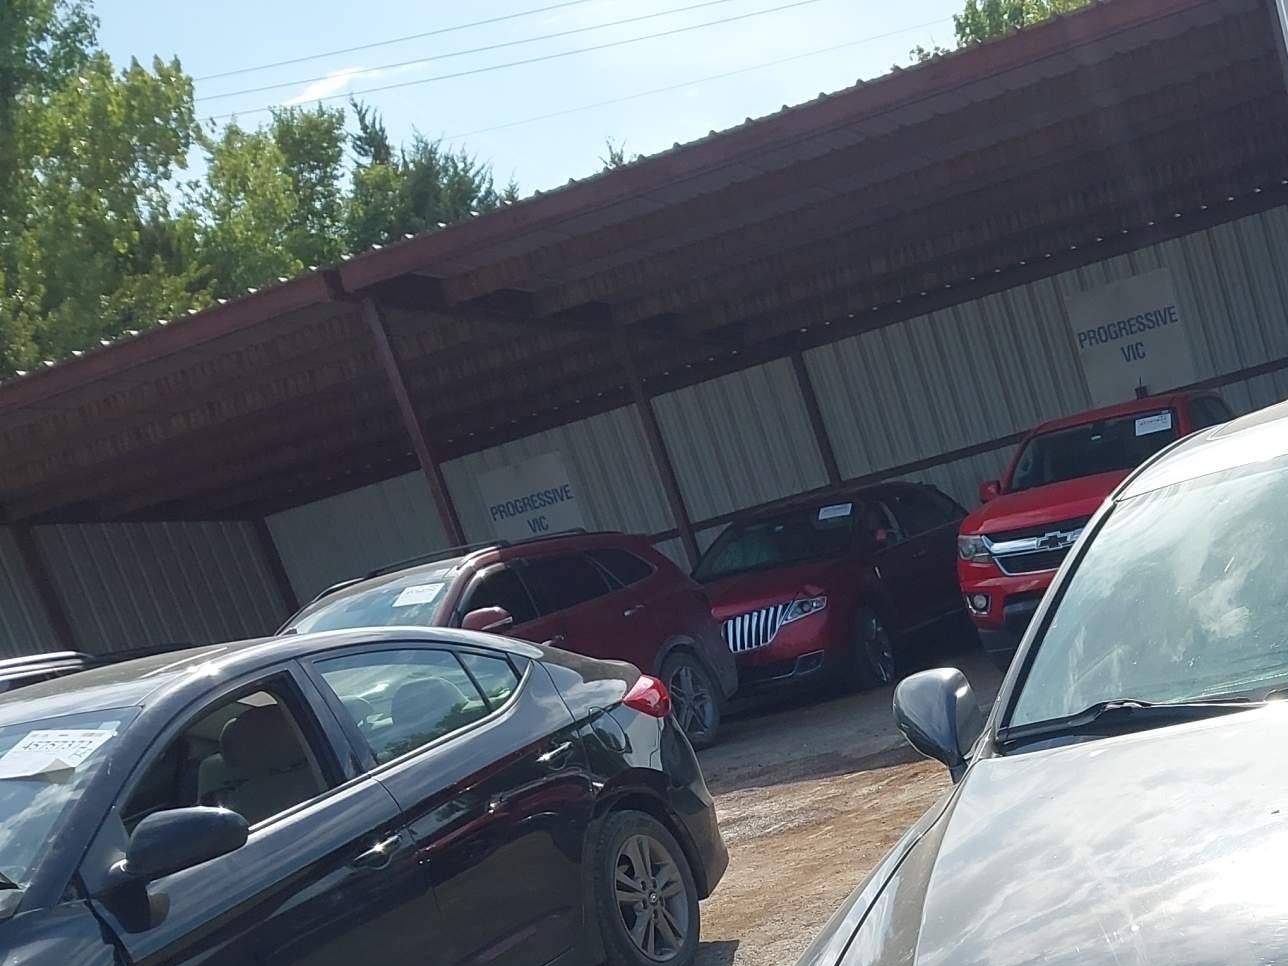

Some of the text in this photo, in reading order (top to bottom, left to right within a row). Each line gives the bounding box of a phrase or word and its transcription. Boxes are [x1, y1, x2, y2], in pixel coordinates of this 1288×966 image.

[1078, 305, 1178, 348] PROGRESSIVE
[1120, 342, 1146, 362] VIC
[490, 484, 574, 521] PROGRESSIVE
[527, 515, 549, 533] VIC
